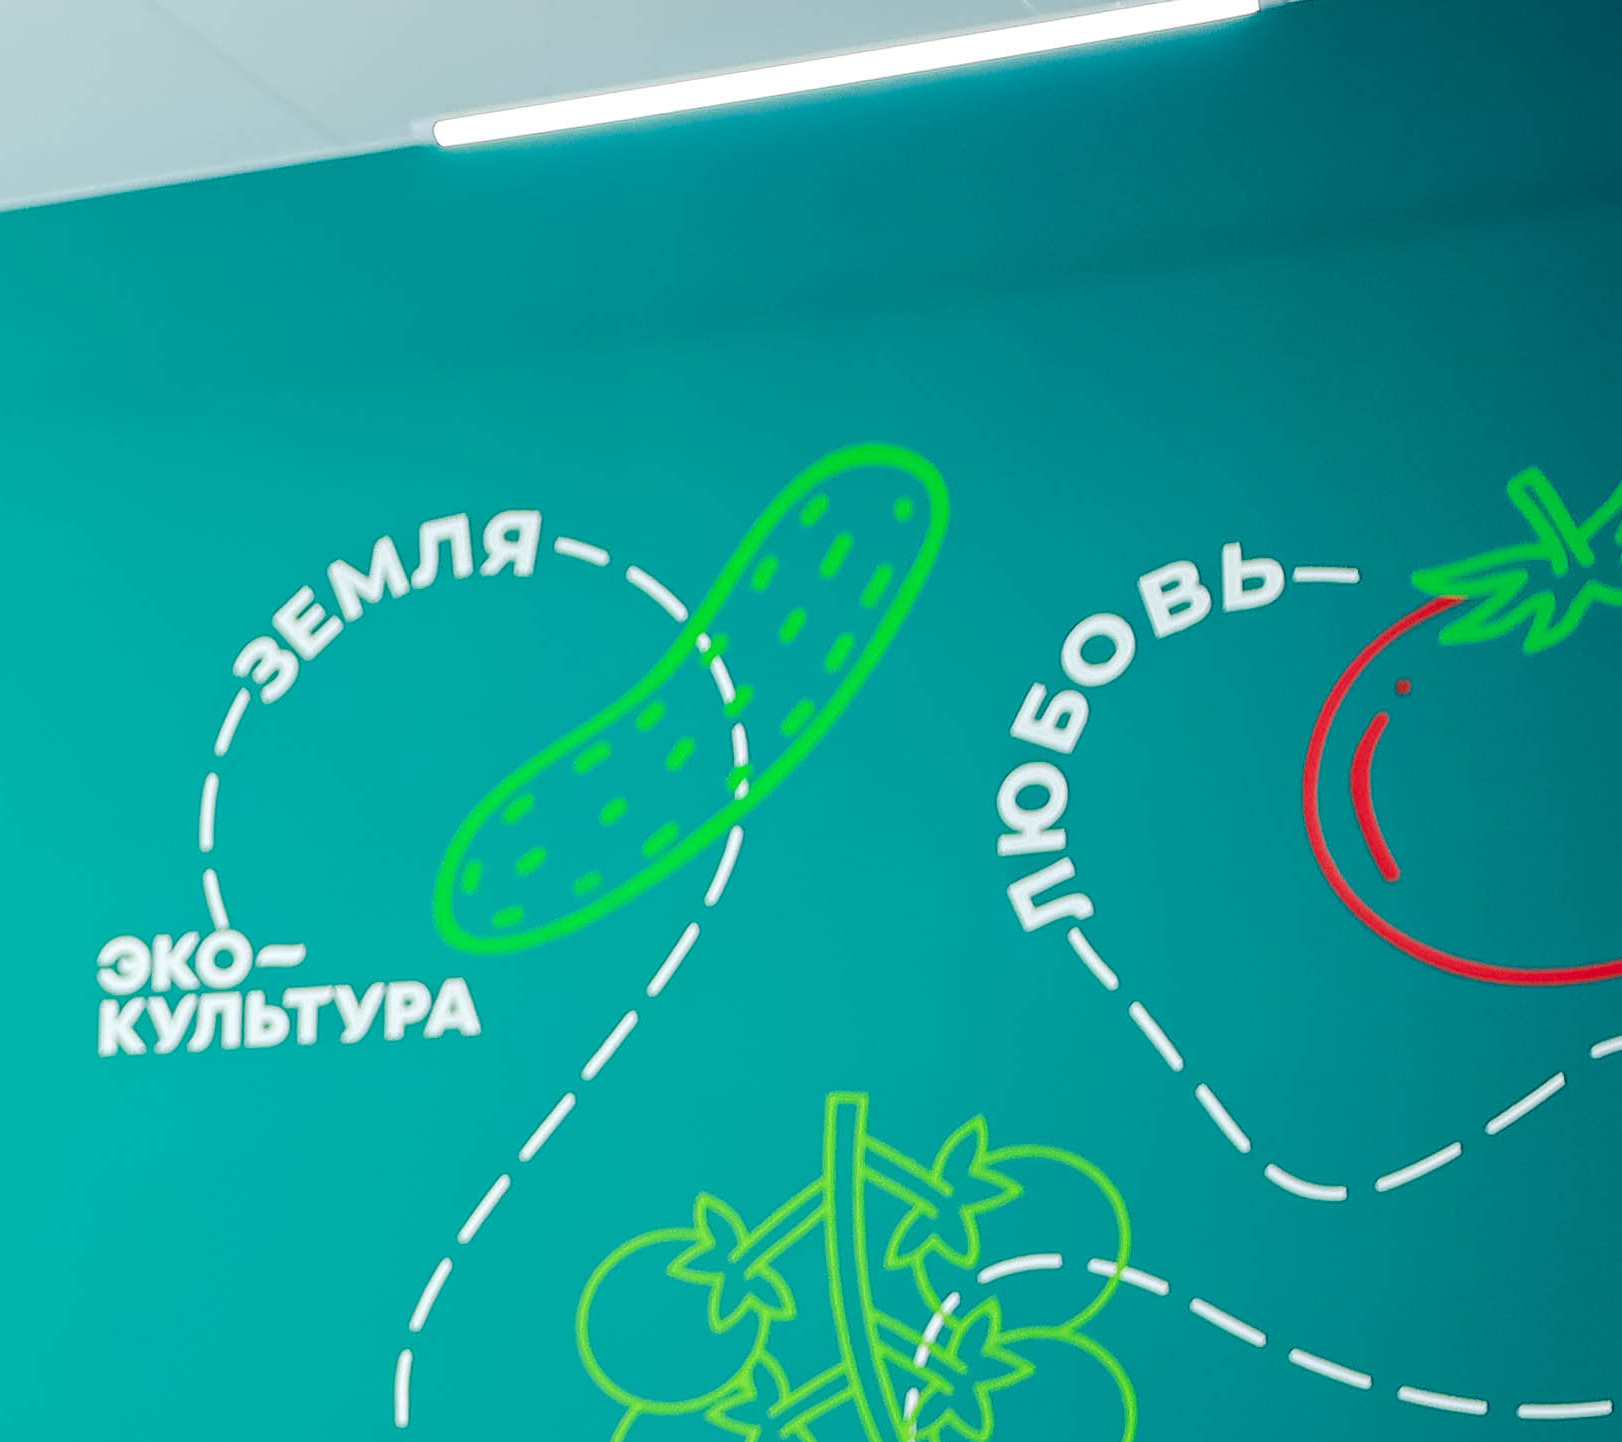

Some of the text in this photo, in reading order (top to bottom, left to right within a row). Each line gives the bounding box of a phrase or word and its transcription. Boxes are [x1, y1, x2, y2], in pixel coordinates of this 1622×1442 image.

[232, 510, 543, 704] ЗЕМЛЯ
[997, 542, 1285, 932] ЛЮБОВЬ
[97, 977, 482, 1058] КУЛЬТУРА
